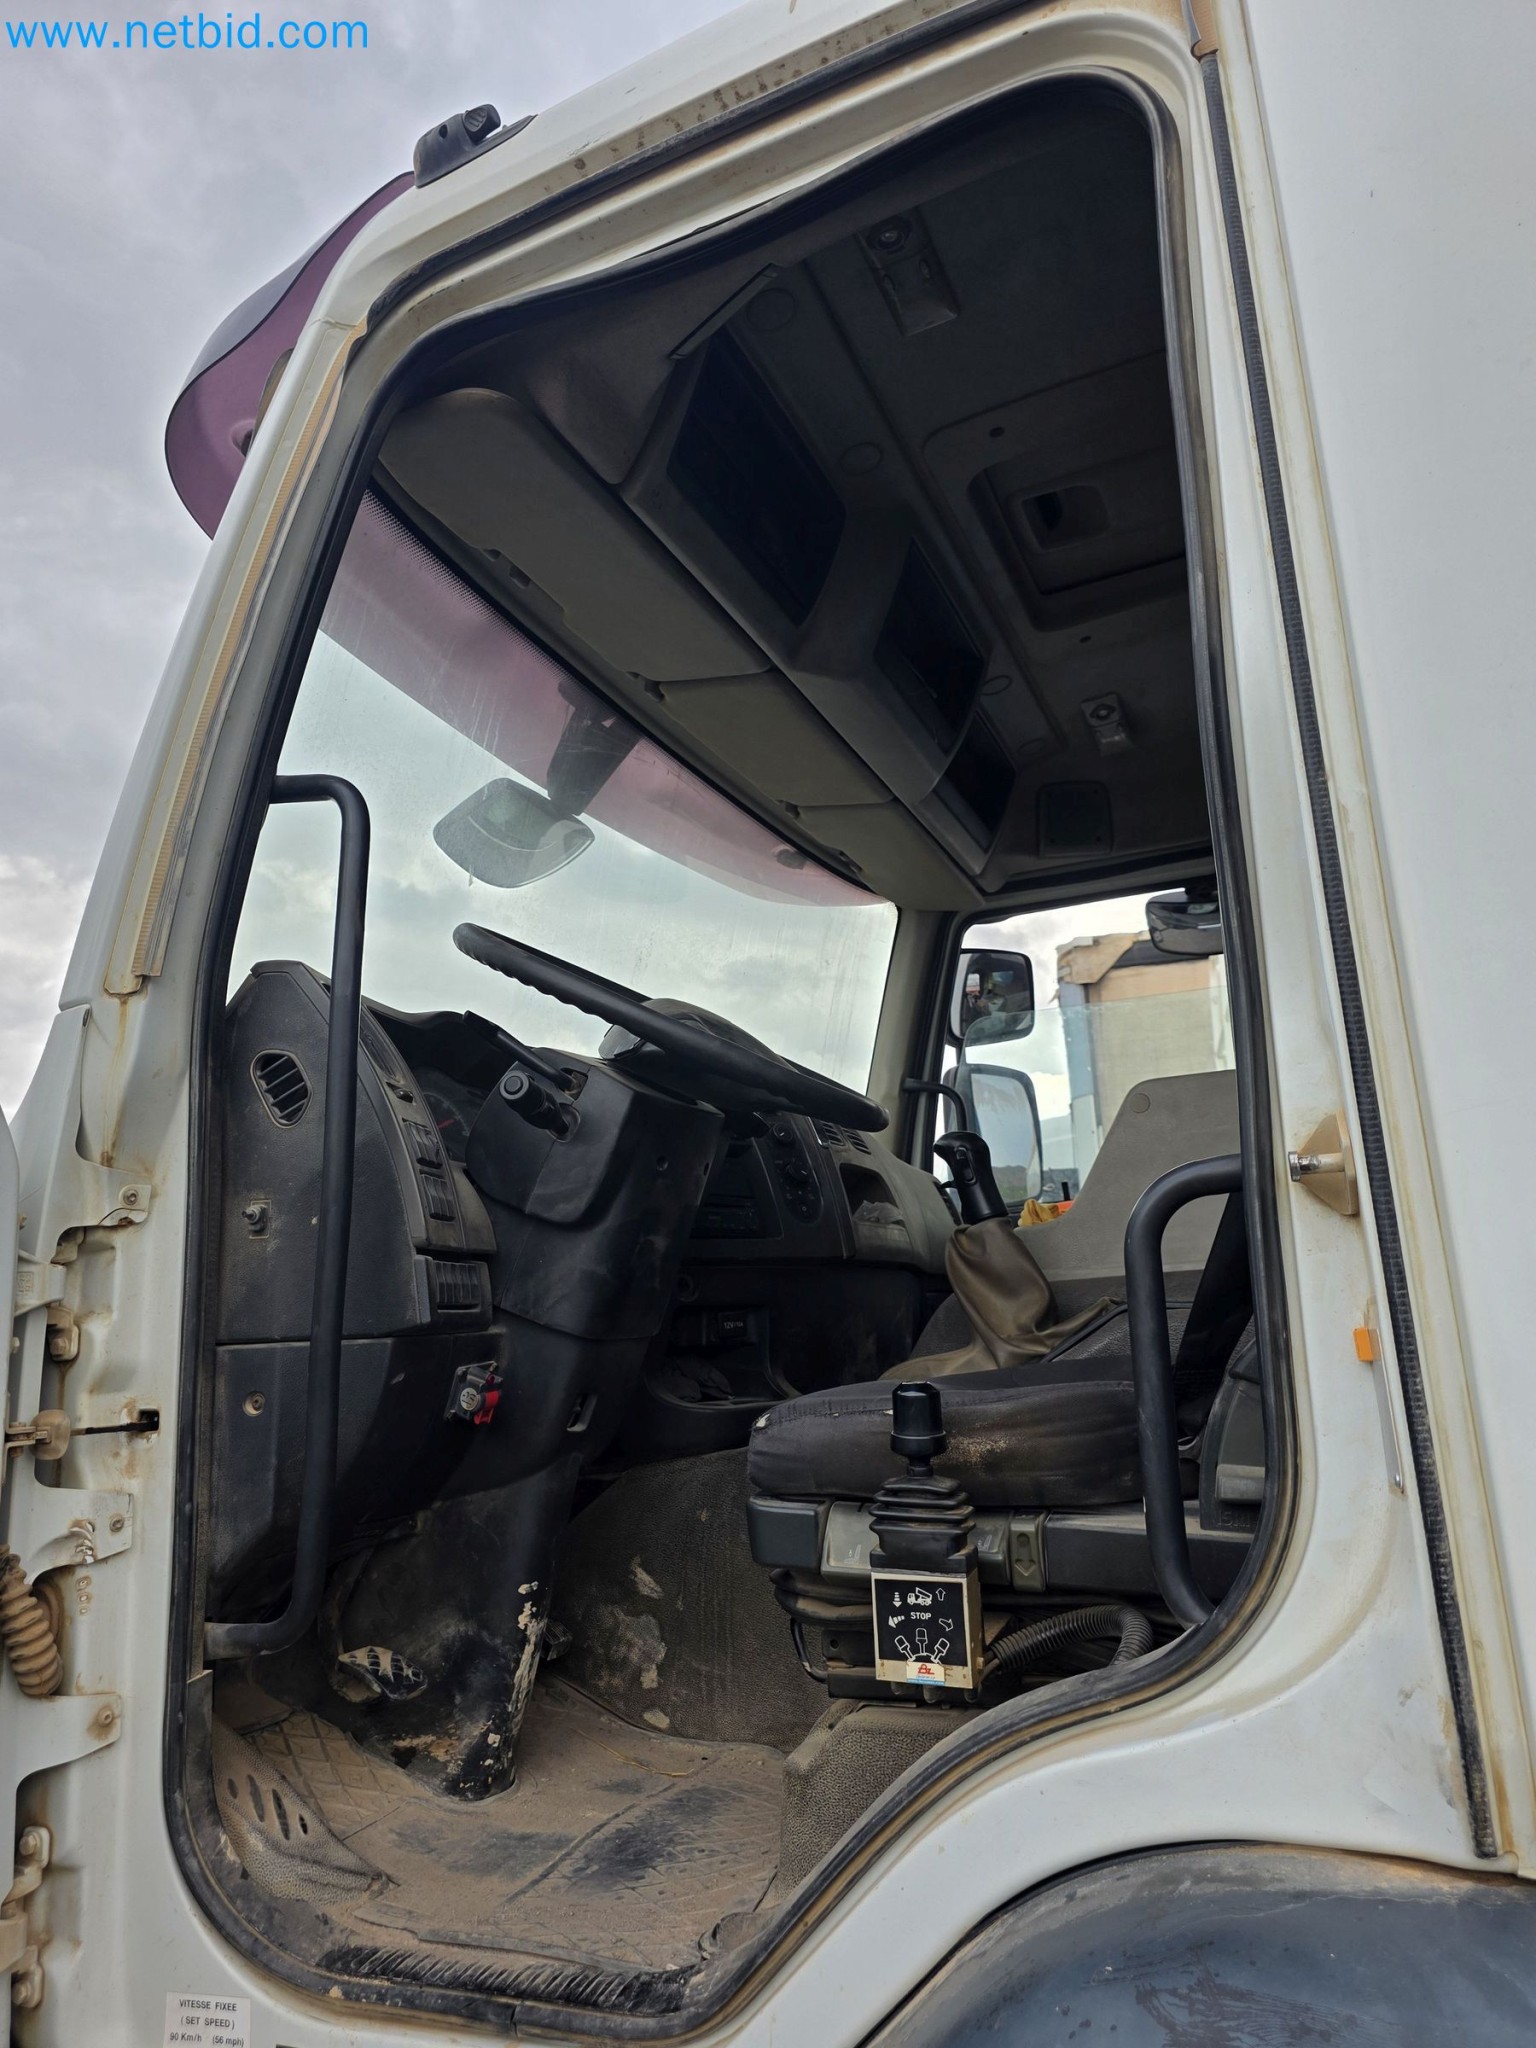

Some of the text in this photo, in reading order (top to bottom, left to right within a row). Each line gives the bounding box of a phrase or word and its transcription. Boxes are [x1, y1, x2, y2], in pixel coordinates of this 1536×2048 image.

[910, 1612, 932, 1620] STOP
[179, 1999, 237, 2012] VITESSE FIXEE
[169, 2032, 245, 2047] 90 Km/h (56 mph)
